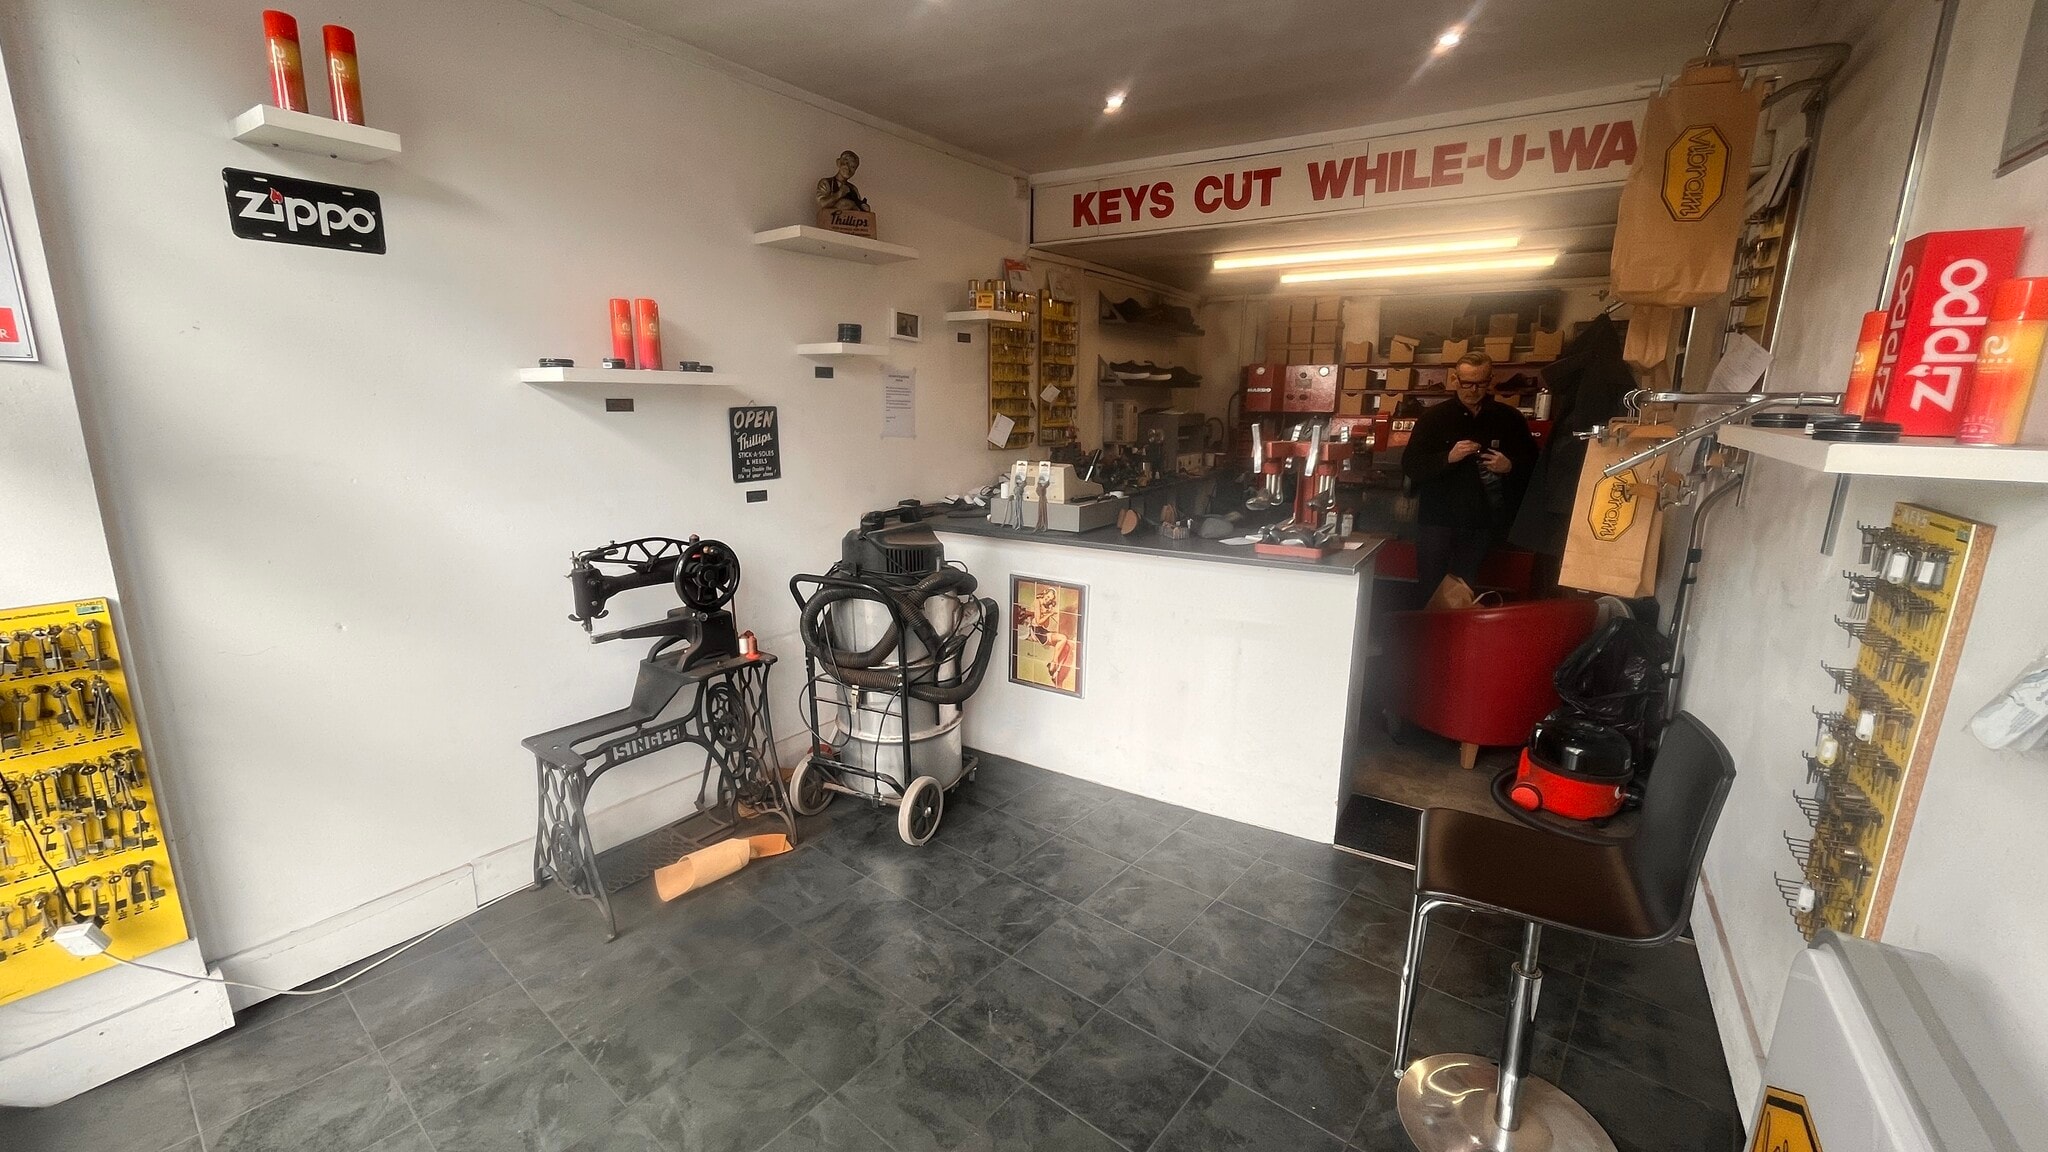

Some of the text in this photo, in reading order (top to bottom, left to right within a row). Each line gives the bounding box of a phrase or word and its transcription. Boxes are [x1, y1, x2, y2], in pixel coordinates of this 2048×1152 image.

[1073, 182, 1175, 228] KEYS
[1194, 166, 1282, 214] CUT
[1680, 129, 1716, 216] Vibram
[235, 187, 376, 236] Zippo
[830, 210, 868, 228] Phillips
[1872, 264, 1914, 410] Zippo
[1905, 258, 1988, 412] Zippo
[733, 410, 774, 429] OPEN
[737, 432, 773, 451] Phillips
[612, 724, 683, 761] SINGER
